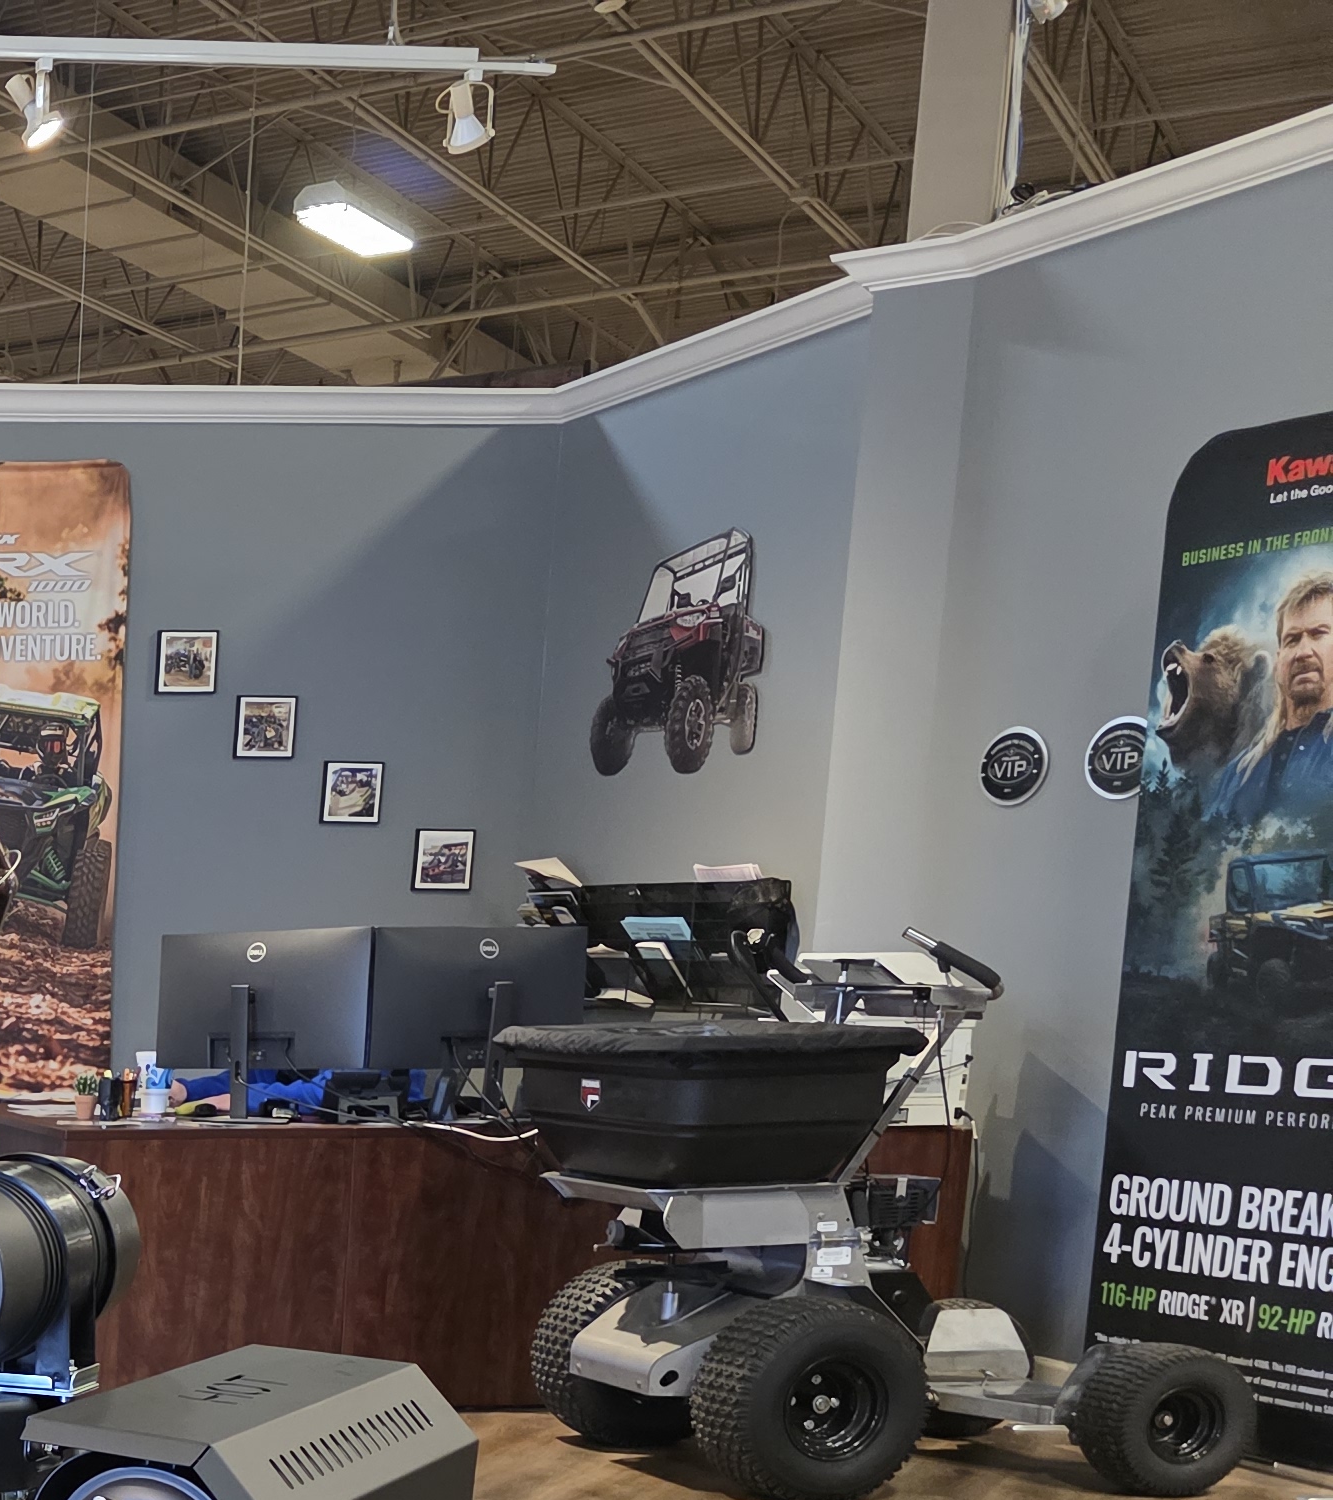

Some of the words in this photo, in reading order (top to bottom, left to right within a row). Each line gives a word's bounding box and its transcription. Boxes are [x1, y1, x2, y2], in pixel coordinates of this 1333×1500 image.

[1269, 491, 1288, 504] Let
[1290, 488, 1308, 500] the
[1181, 542, 1244, 567] BUSINESS
[1247, 539, 1262, 555] IN
[1265, 534, 1291, 552] THE
[28, 579, 92, 592] 1000
[993, 760, 1027, 779] VIP
[1102, 751, 1139, 771] VIP
[1140, 1103, 1177, 1119] PEAK
[1184, 1105, 1257, 1125] PREMIUM
[1265, 1111, 1333, 1130] PERFOR
[1109, 1173, 1232, 1227] GROUND
[1102, 1223, 1273, 1284] 4-CYLINDER
[1101, 1281, 1157, 1311] 116-HP
[1219, 1297, 1245, 1327] XR
[1257, 1304, 1315, 1336] 92-HP
